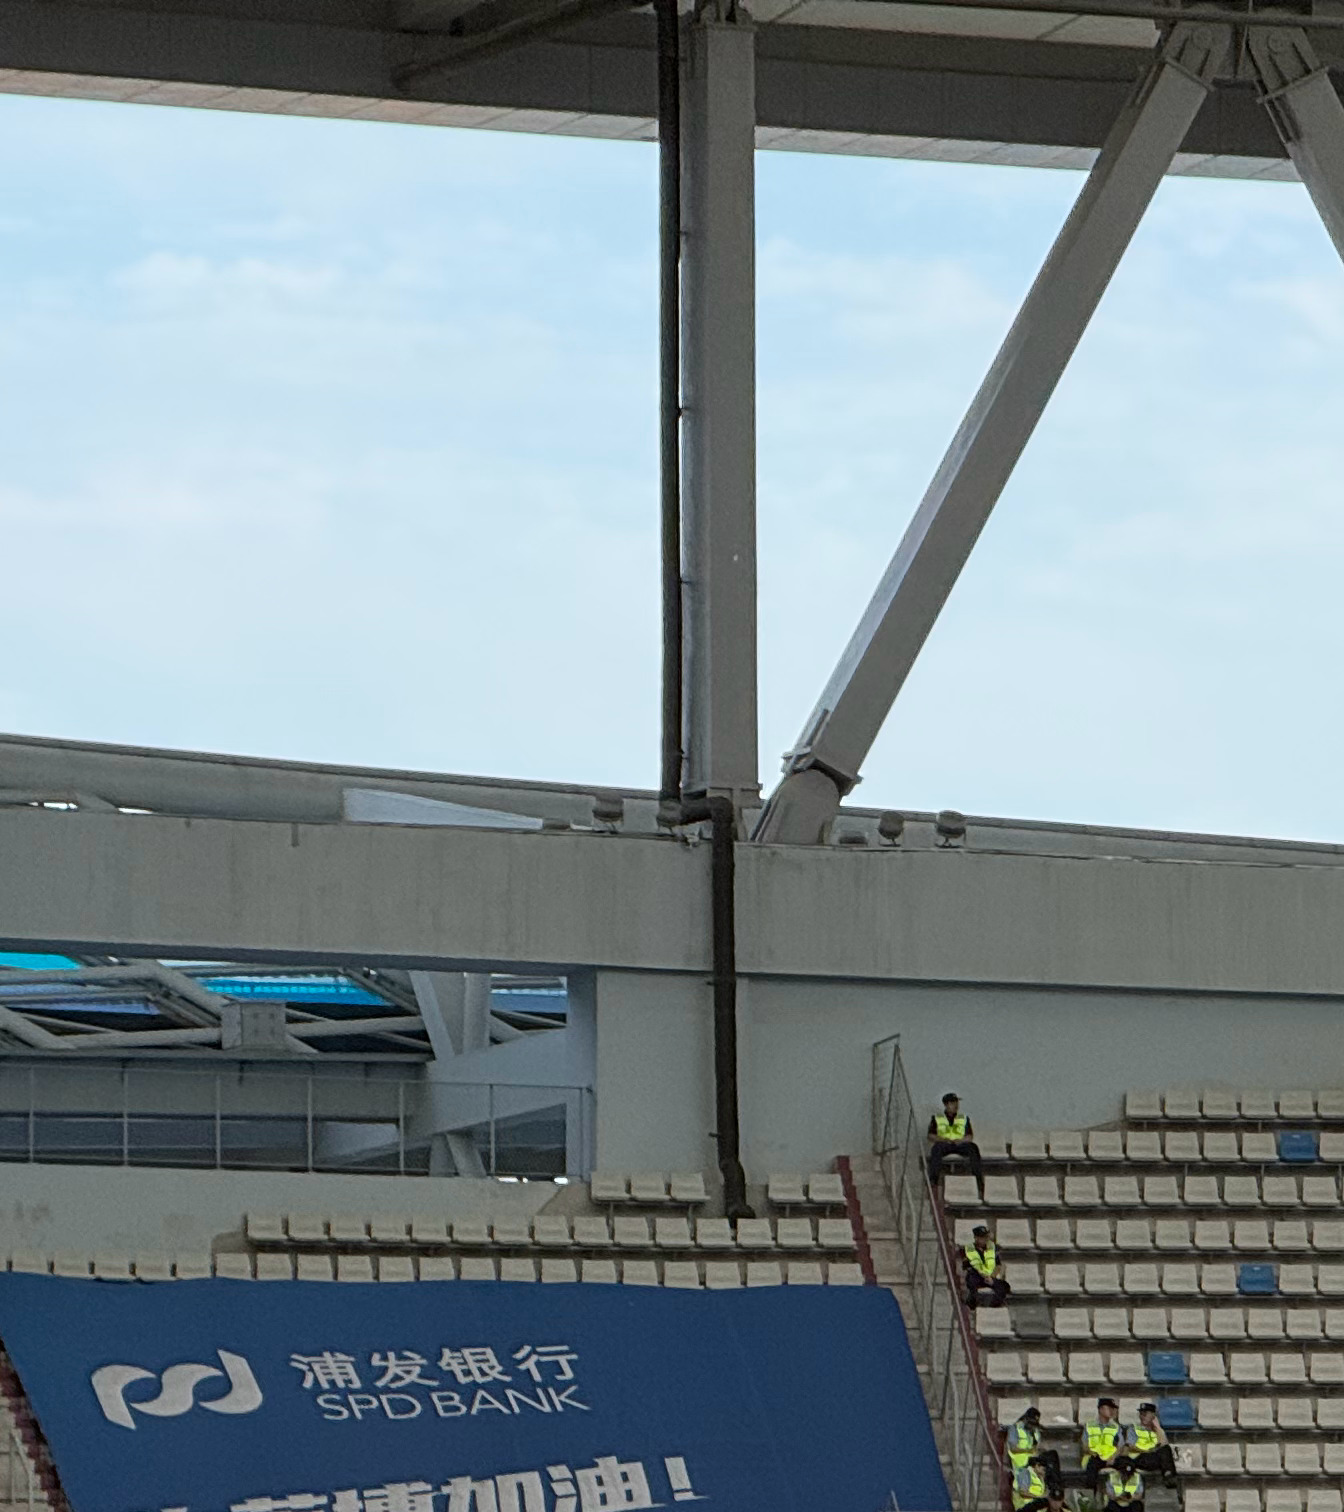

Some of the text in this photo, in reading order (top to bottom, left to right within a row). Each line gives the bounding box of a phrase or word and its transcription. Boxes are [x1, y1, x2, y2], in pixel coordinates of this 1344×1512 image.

[290, 1345, 579, 1390] 浦发银行
[316, 1384, 590, 1421] SPD BANK
